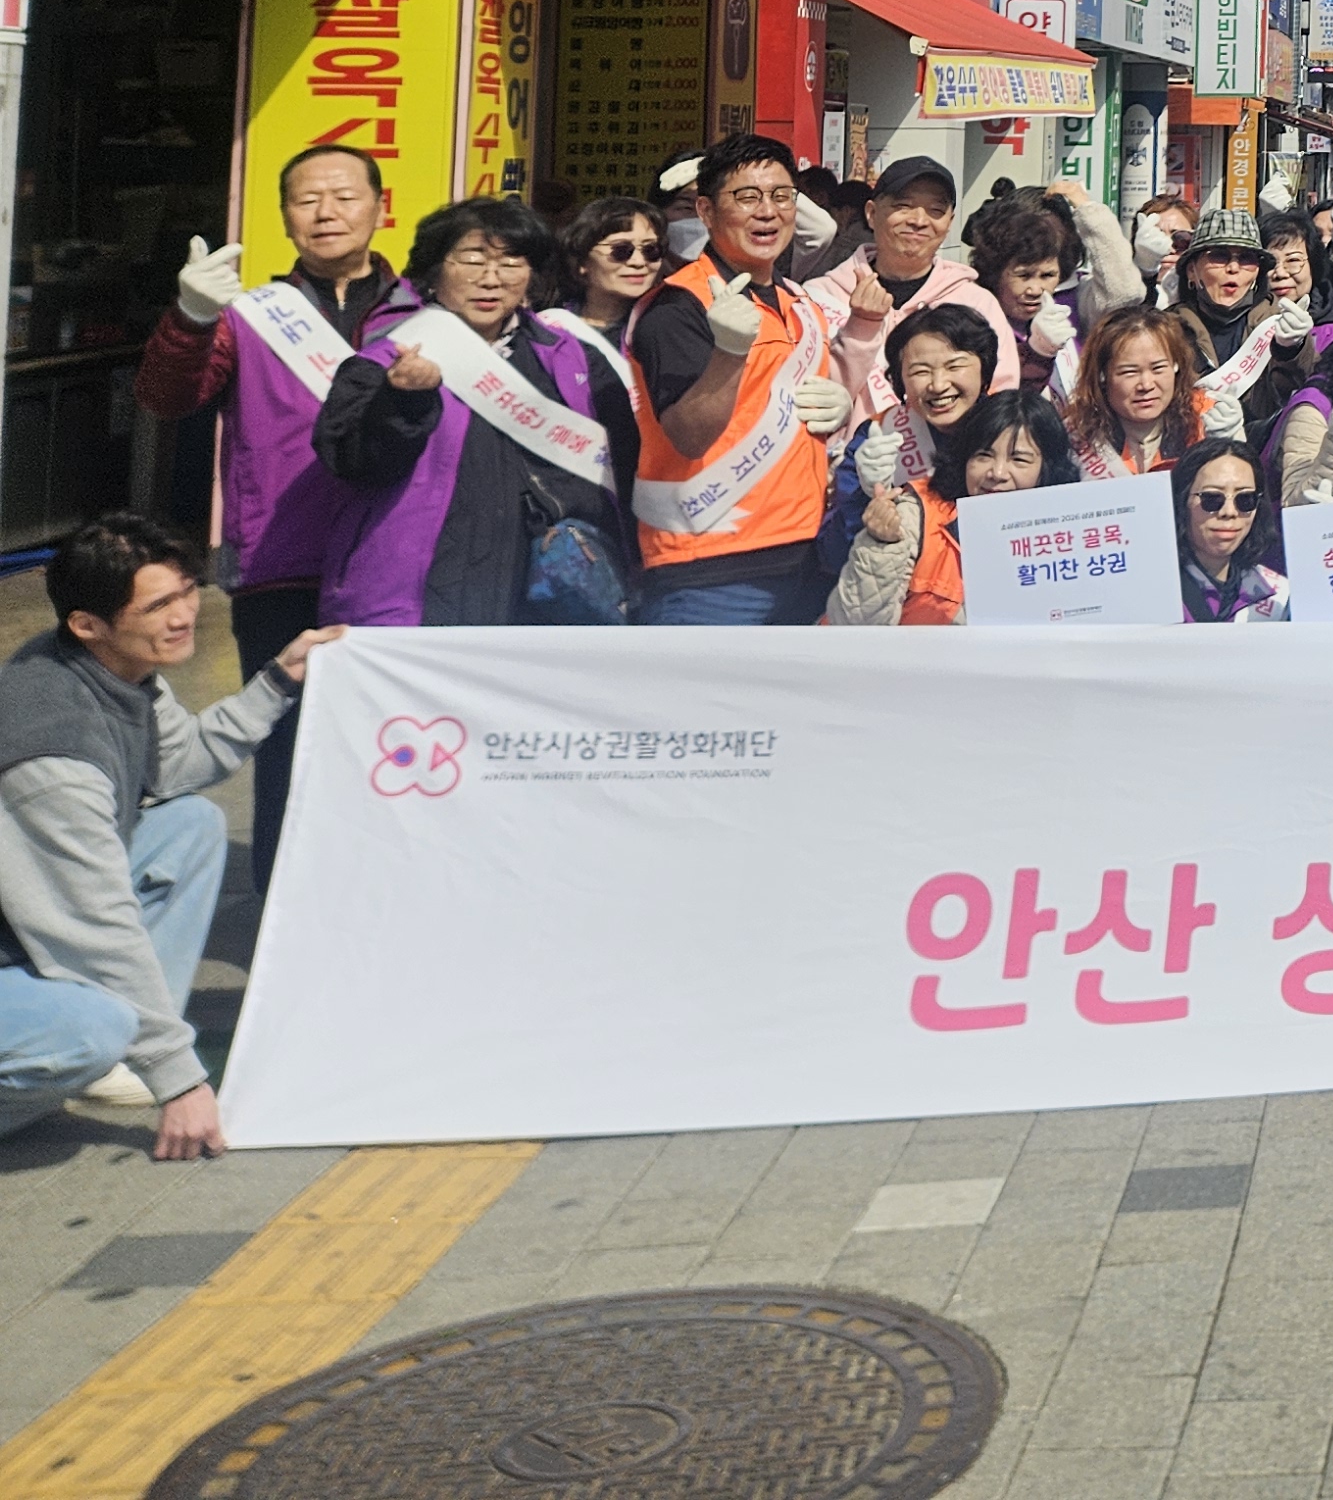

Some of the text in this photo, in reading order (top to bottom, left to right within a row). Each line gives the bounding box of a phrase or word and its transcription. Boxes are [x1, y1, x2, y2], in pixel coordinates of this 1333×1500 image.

[730, 435, 775, 482] 먼저
[1061, 514, 1080, 522] 2026
[1010, 524, 1130, 558] 깨끗한 골목,
[1017, 552, 1127, 587] 활기찬 상권
[483, 729, 778, 762] 안산시상권활성화재단
[908, 865, 1215, 1030] 안산
